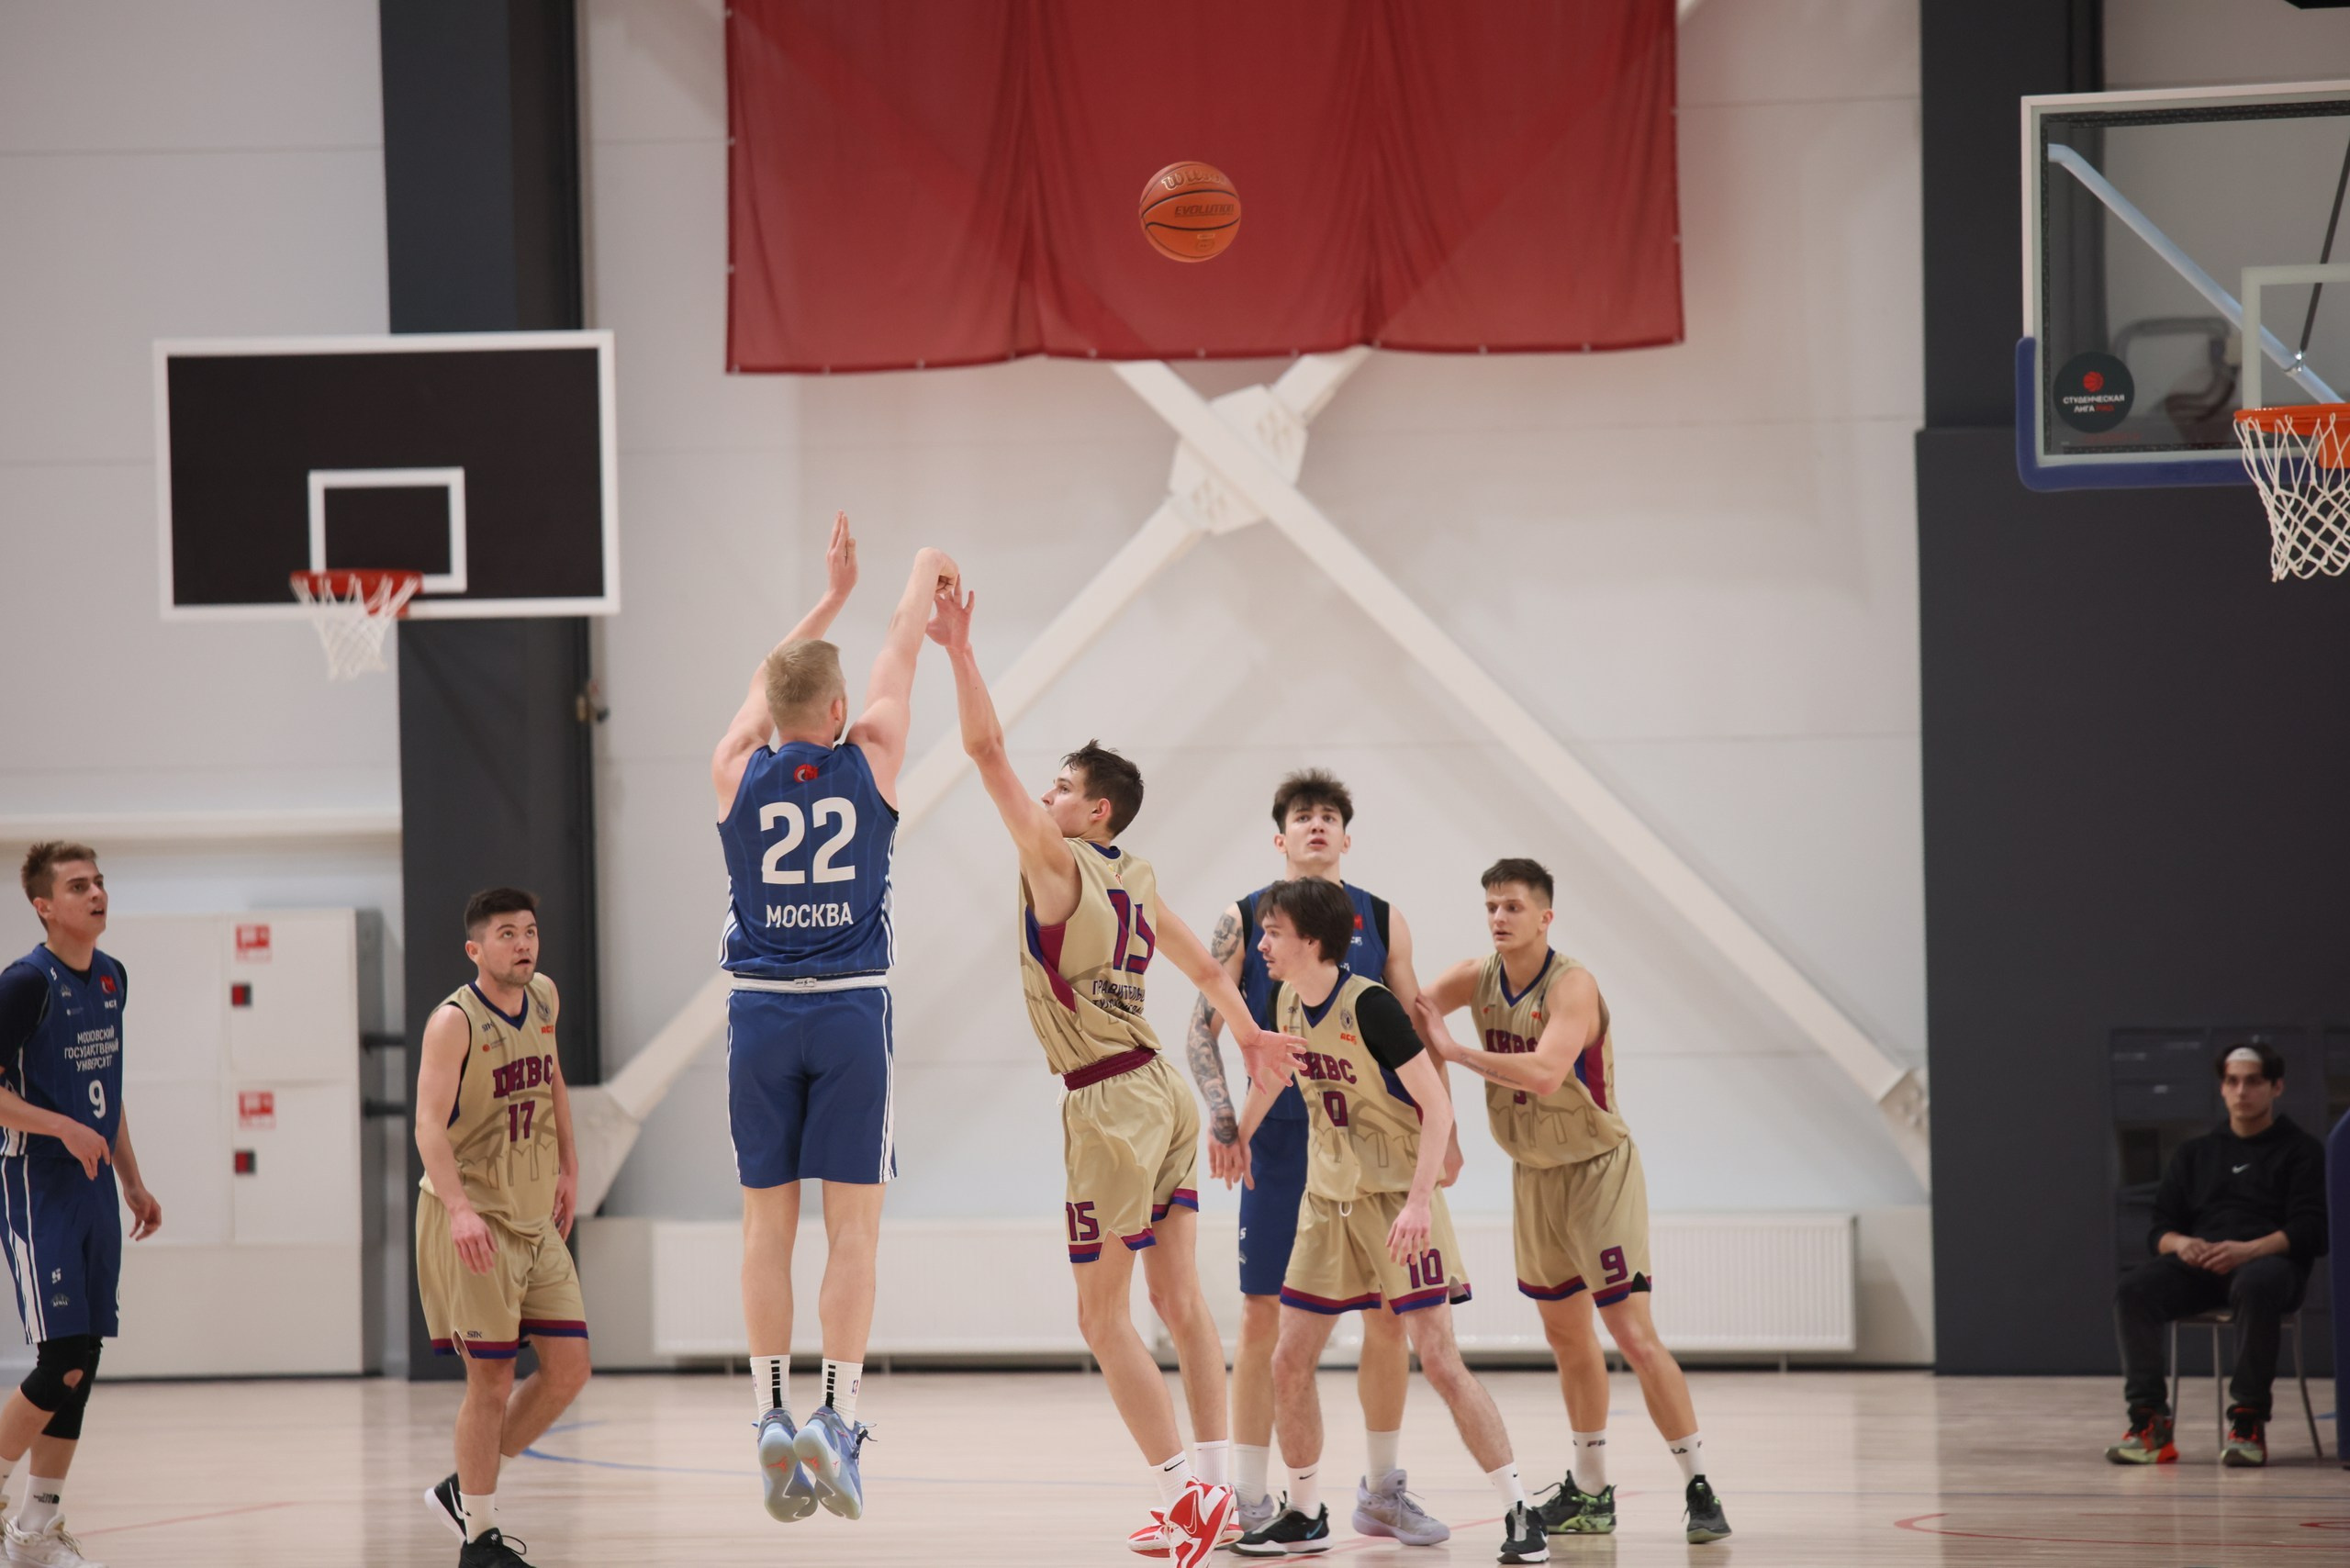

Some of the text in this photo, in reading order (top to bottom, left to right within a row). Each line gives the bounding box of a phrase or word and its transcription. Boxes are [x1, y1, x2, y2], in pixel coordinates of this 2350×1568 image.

[759, 796, 857, 885] 22
[766, 902, 854, 928] МОСКВА
[88, 1080, 106, 1119] 9
[509, 1101, 535, 1142] 17
[1066, 1201, 1100, 1241] 15
[1406, 1249, 1444, 1290] 10
[1600, 1245, 1628, 1284] 9
